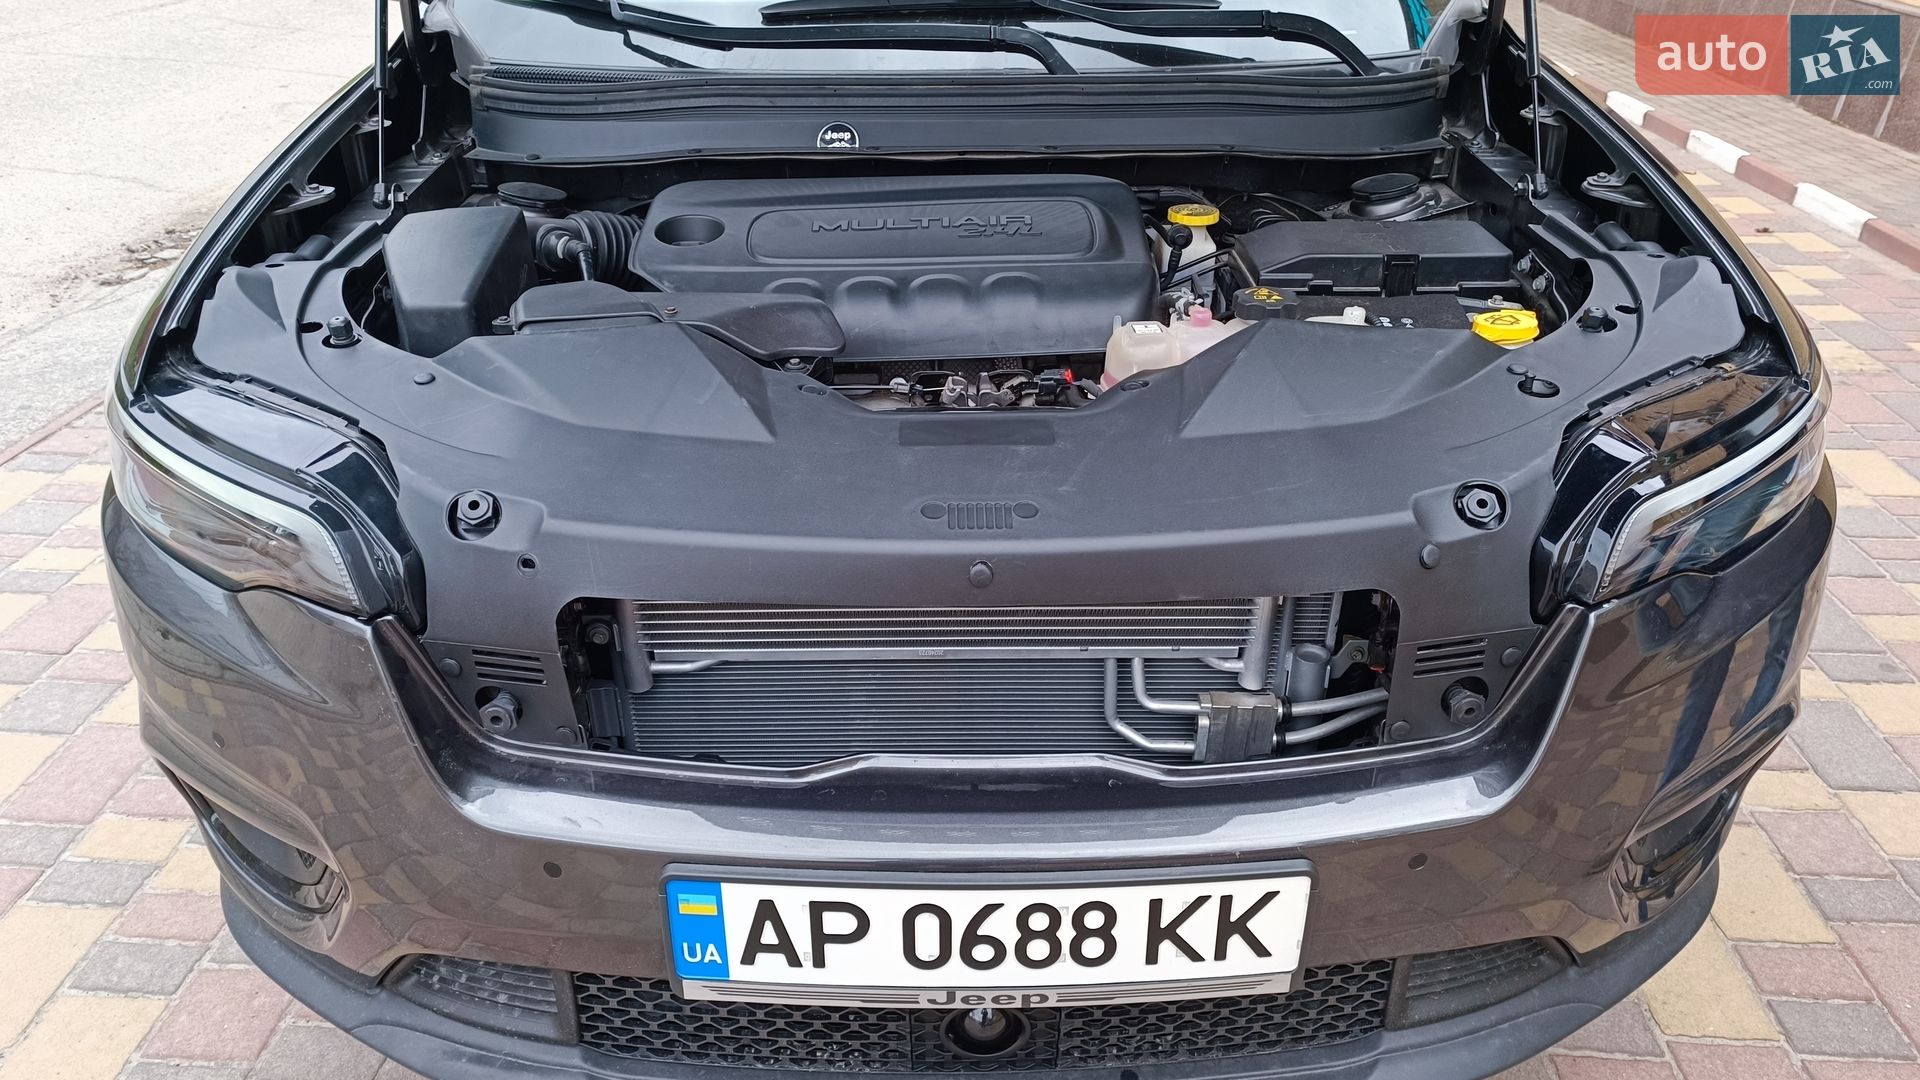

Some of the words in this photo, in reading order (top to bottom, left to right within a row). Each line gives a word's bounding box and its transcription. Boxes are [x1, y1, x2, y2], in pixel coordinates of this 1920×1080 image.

[822, 130, 851, 141] Jeep
[811, 214, 1032, 233] MULTIAIR
[740, 898, 871, 970] AP
[902, 900, 1118, 971] 0688
[1144, 890, 1281, 967] KK
[682, 942, 723, 966] UA
[926, 991, 1050, 1009] Jeep
